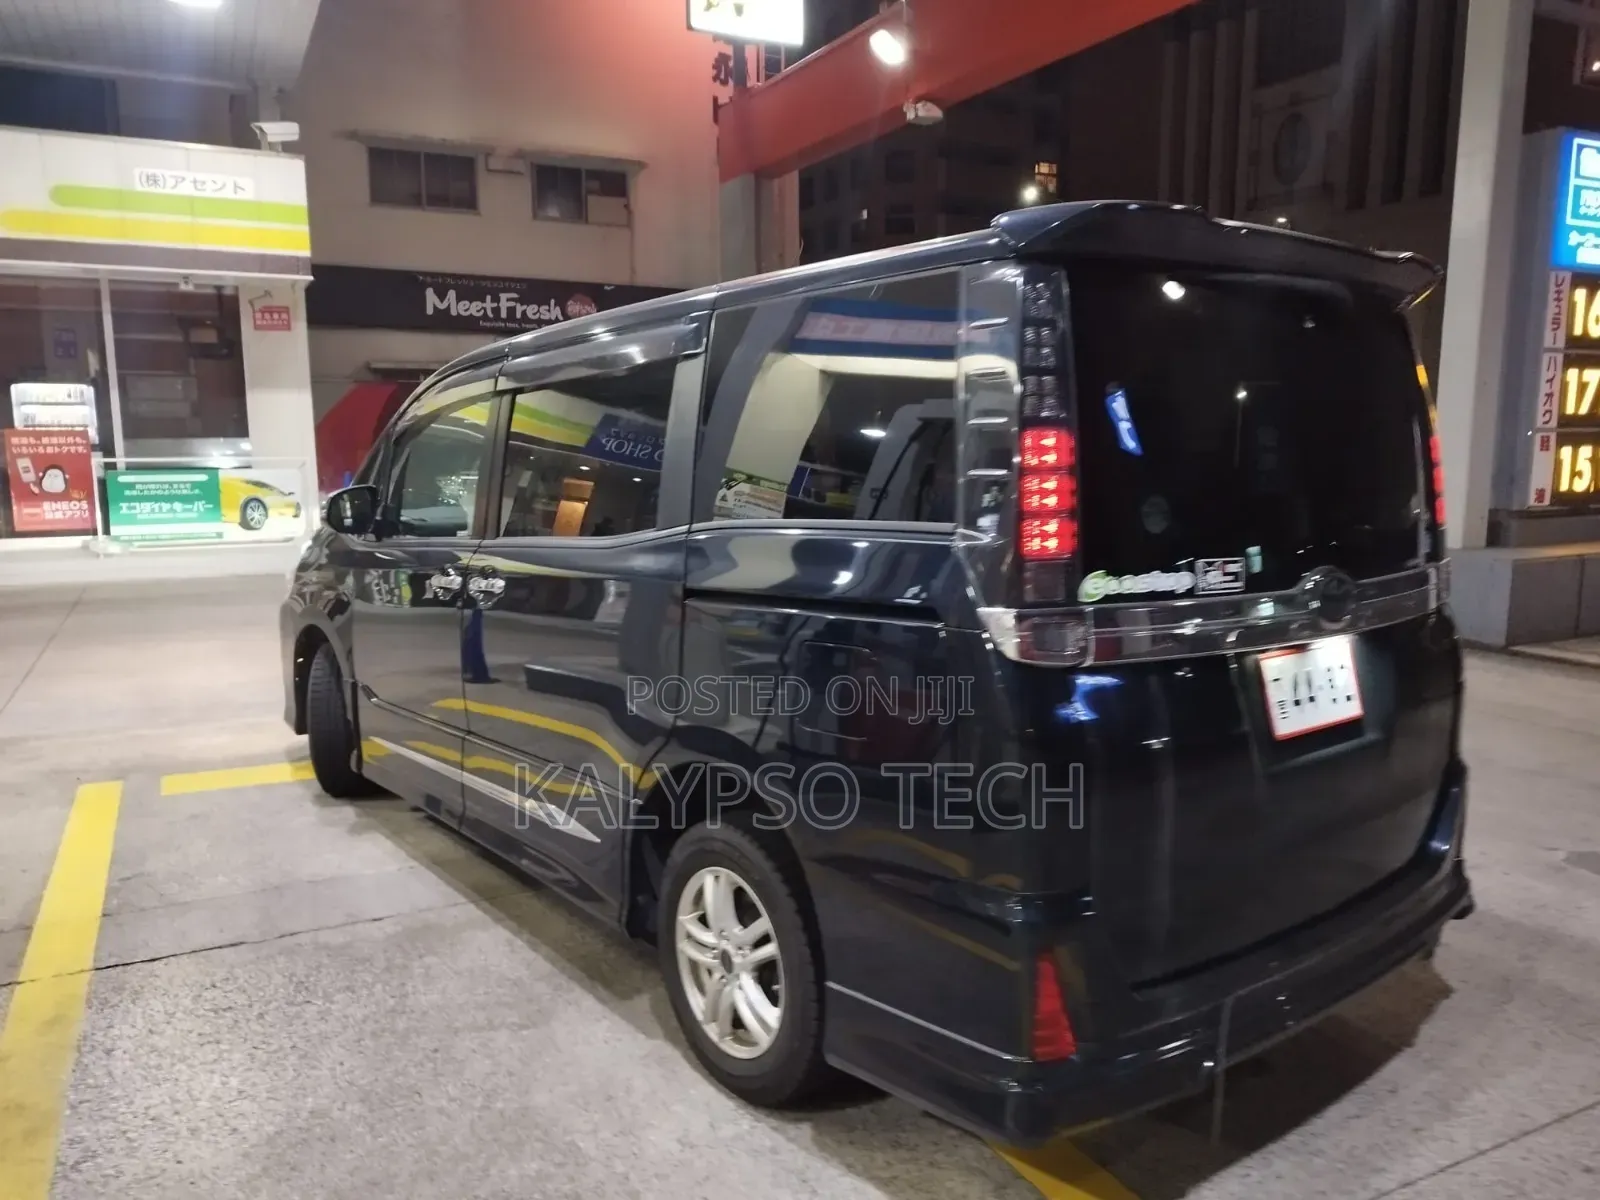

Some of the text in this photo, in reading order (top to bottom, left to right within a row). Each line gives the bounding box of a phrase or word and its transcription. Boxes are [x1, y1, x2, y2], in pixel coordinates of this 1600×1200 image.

[139, 170, 246, 195] (株)アセント
[1550, 274, 1565, 346] レギュラー
[1542, 356, 1557, 425] ハイオク
[42, 500, 89, 511] ENEOS
[119, 500, 214, 514] エコダイヤキーパー
